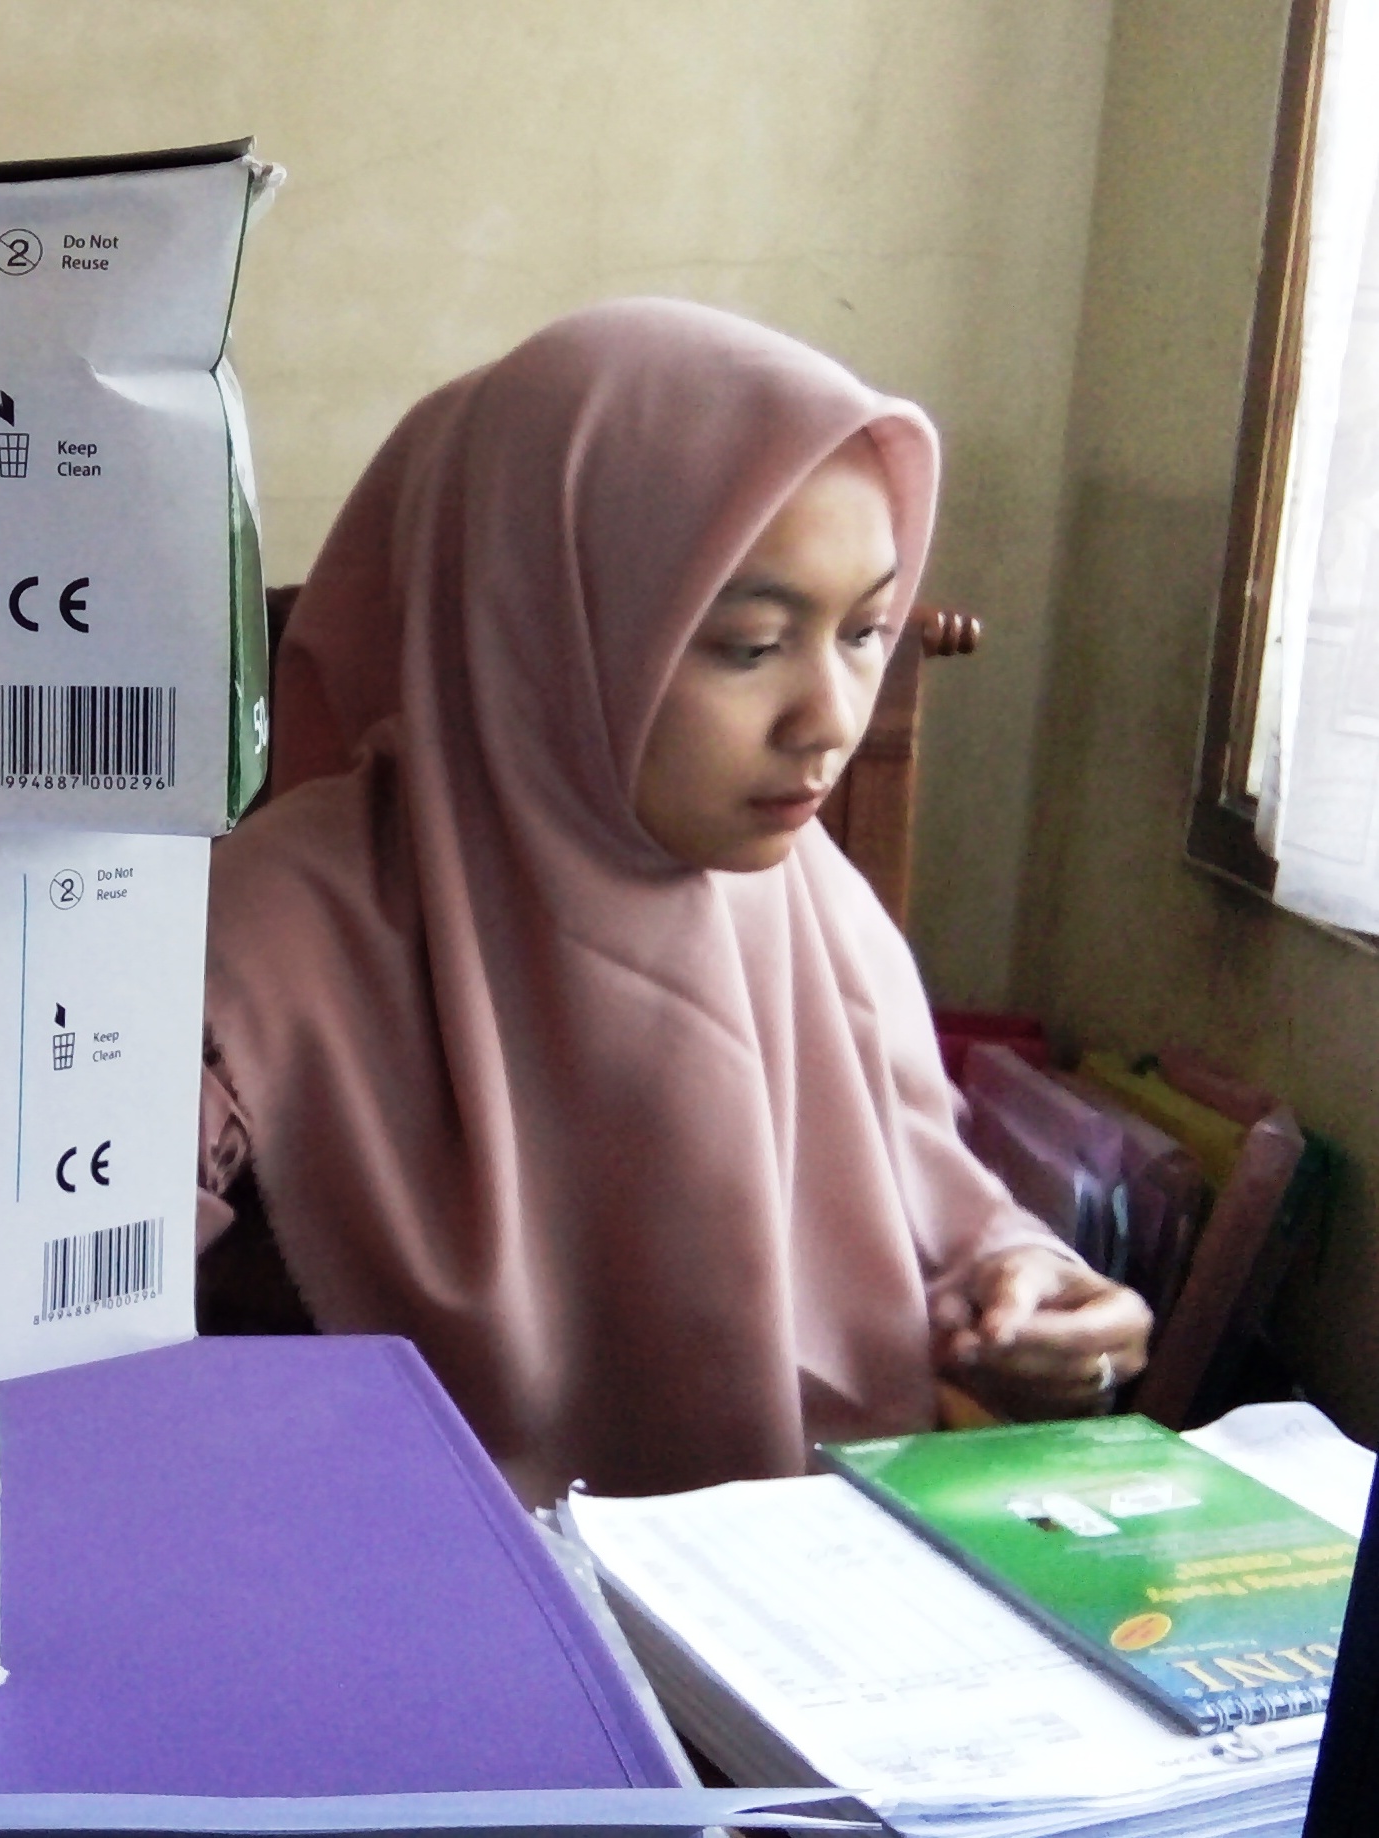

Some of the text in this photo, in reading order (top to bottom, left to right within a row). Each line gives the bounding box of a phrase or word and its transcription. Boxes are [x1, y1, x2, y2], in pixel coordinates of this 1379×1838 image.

[63, 234, 120, 250] Do Not
[5, 239, 30, 269] 2
[61, 254, 110, 271] Reuse
[57, 439, 98, 459] Keep
[56, 461, 102, 477] Clean
[7, 575, 90, 634] CE
[5, 774, 80, 790] 994887
[90, 775, 166, 791] 000296
[97, 867, 134, 882] Do Not
[58, 877, 76, 903] 2
[96, 888, 128, 901] Reuse
[93, 1031, 120, 1044] Keep
[91, 1049, 122, 1063] Clean
[54, 1139, 112, 1195] CE
